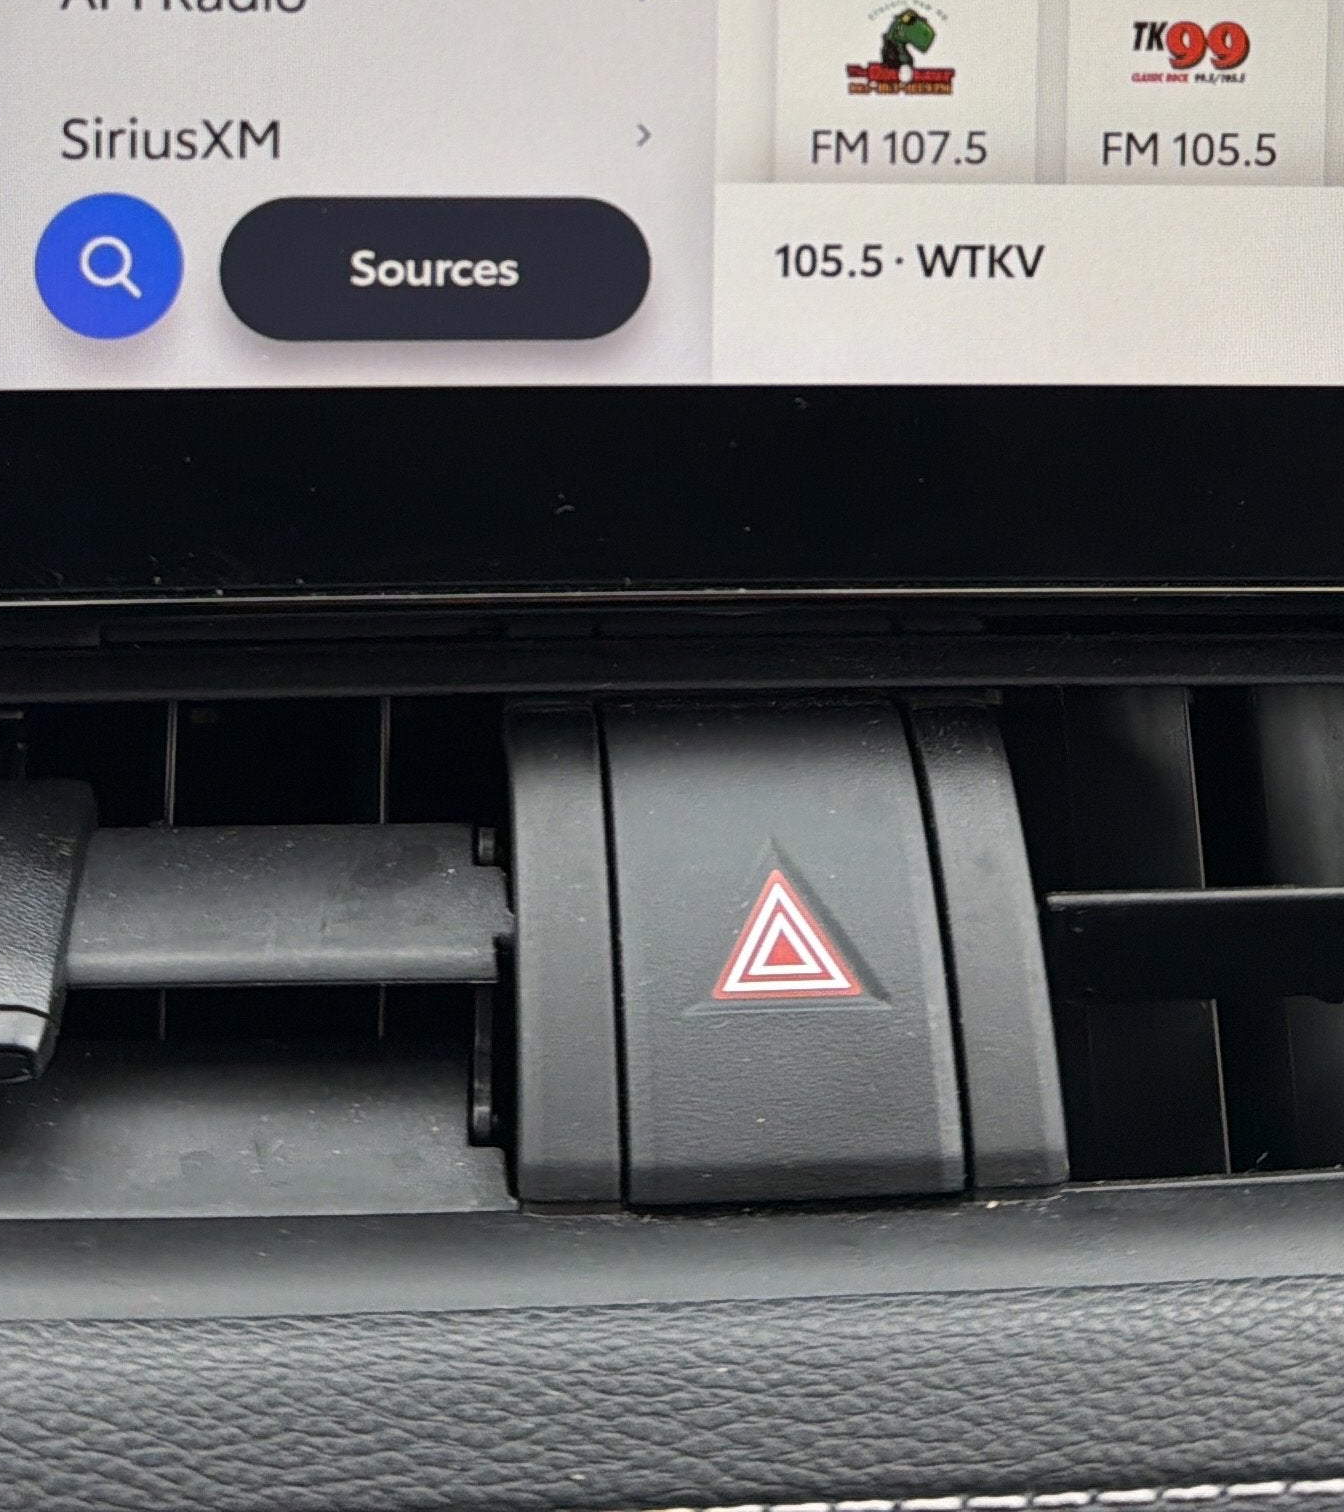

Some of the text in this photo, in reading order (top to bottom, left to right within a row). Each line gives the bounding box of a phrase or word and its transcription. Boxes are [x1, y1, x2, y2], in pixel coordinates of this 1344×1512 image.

[1133, 20, 1250, 70] TK99
[60, 115, 281, 161] SiriusXM
[811, 128, 988, 166] FM 107.5
[1101, 130, 1278, 168] FM 105.5
[349, 248, 521, 288] Sources
[774, 243, 884, 279] 105.5
[915, 243, 1046, 279] WTKV
